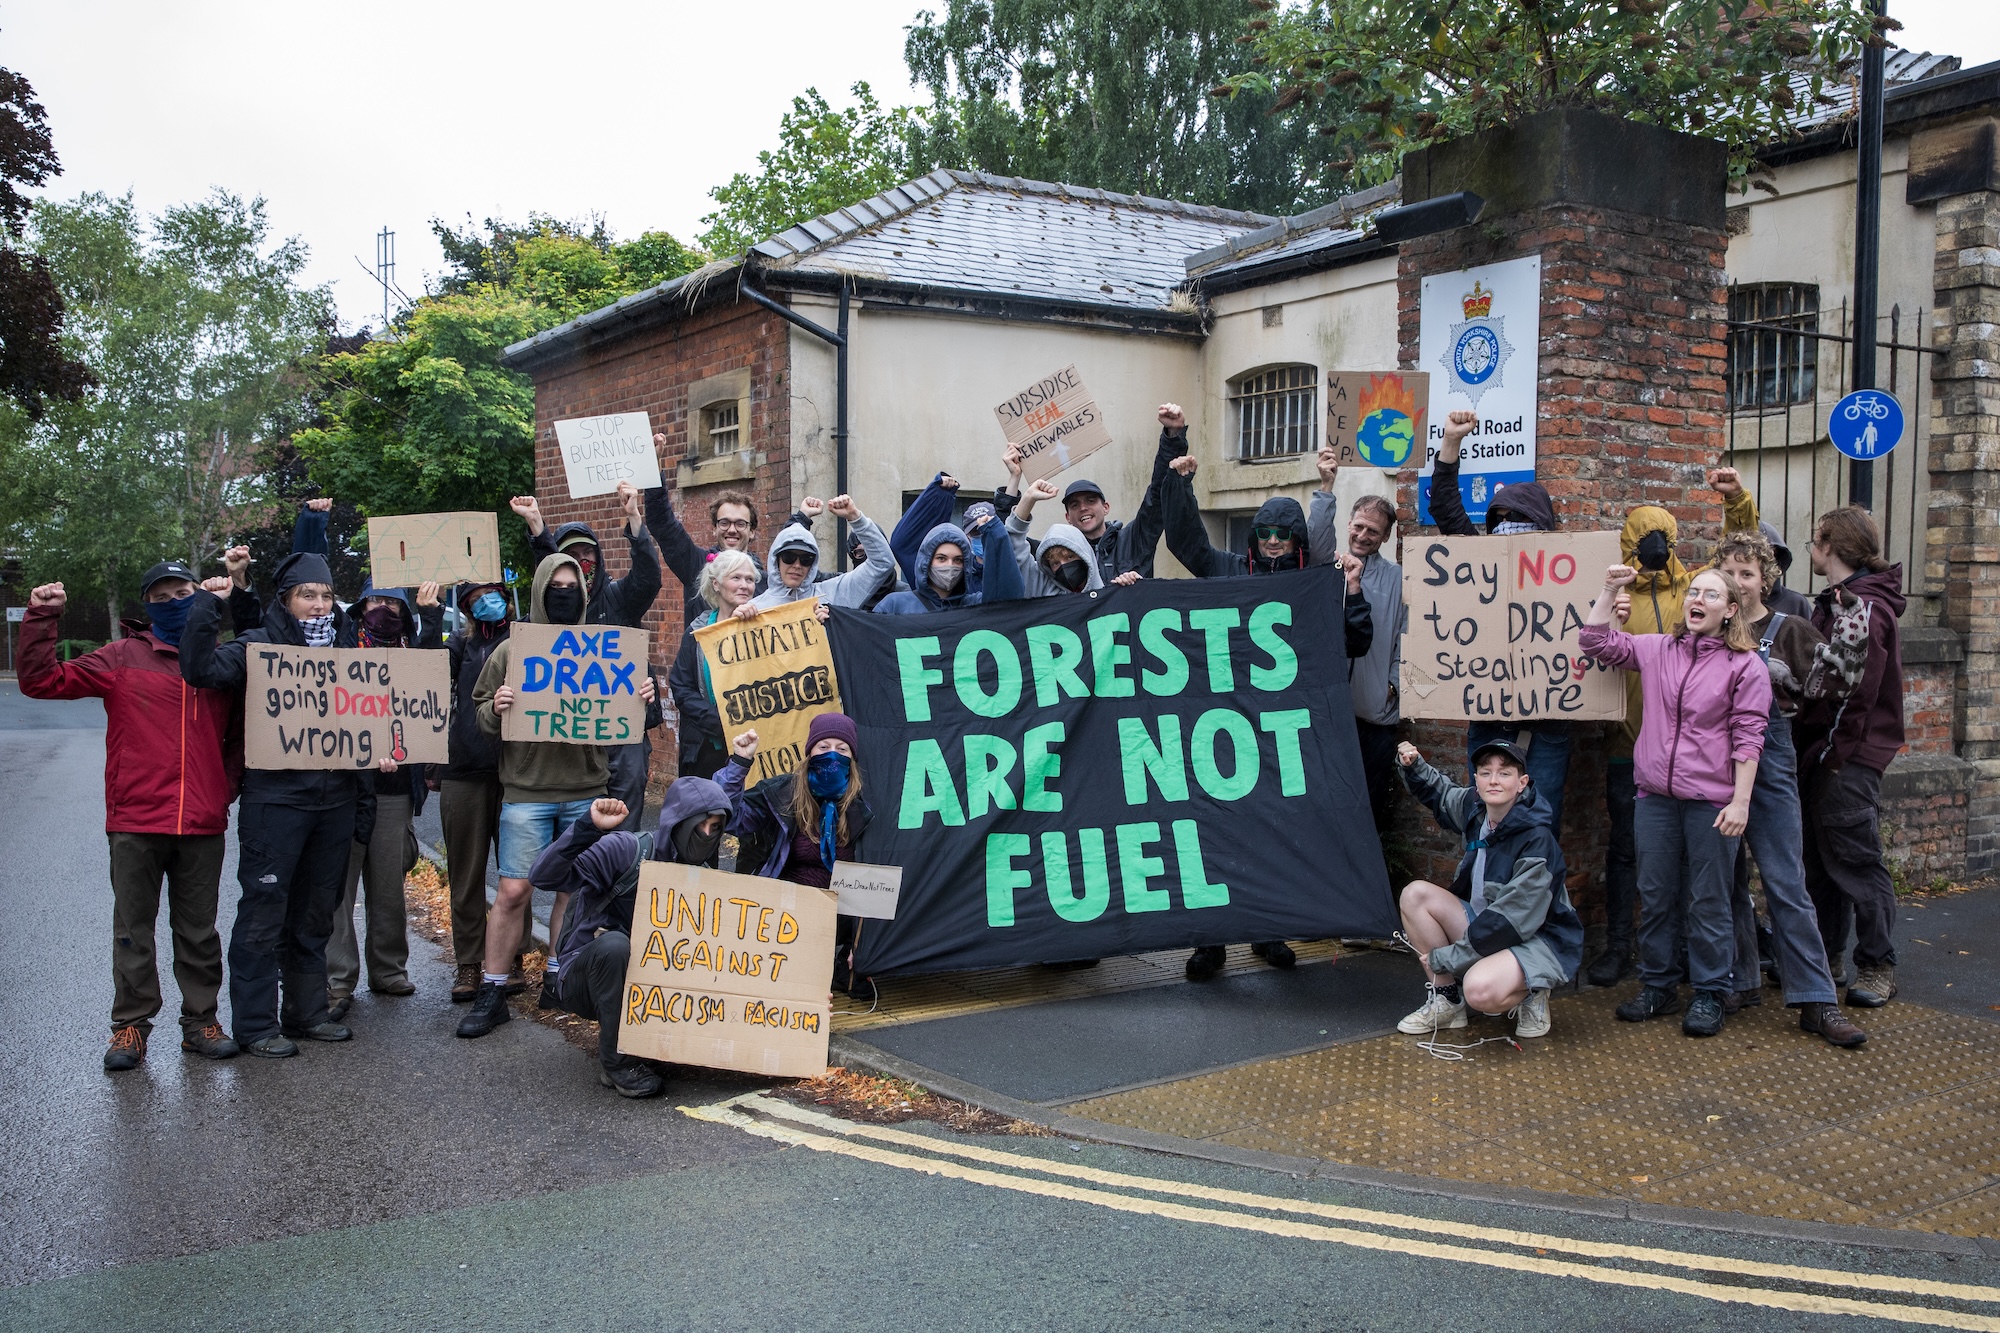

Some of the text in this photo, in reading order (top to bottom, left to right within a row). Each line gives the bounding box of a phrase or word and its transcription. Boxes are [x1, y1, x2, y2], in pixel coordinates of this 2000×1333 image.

[1455, 328, 1498, 373] NORTH YORKSHIRE POLICE
[998, 369, 1081, 424] SUBSIDISE
[1023, 400, 1066, 433] REAL
[579, 416, 624, 439] STOP
[1484, 415, 1523, 435] Road
[570, 435, 645, 464] BURNING
[1471, 440, 1525, 459] Station
[584, 461, 635, 483] TREES
[371, 516, 487, 551] AXE
[1422, 543, 1577, 604] Say NO
[717, 618, 819, 665] CLIMATE
[1423, 599, 1614, 646] to DRA
[550, 630, 622, 660] AXE
[895, 601, 1299, 722] FORESTS
[259, 651, 391, 688] Things are
[521, 656, 636, 696] DRAX
[1436, 648, 1570, 685] Stealing
[266, 684, 448, 733] going Draxtically
[560, 697, 611, 715] NOT
[729, 669, 832, 722] JUSTICE
[1463, 683, 1584, 718] future
[278, 724, 372, 768] wrong
[524, 710, 630, 741] TREES
[897, 708, 1311, 830] ARE NOT
[985, 818, 1231, 928] FUEL
[649, 887, 799, 944] UNITED
[639, 930, 788, 982] AGAINST
[626, 983, 725, 1026] RACISM
[743, 1000, 820, 1034] FACISM
